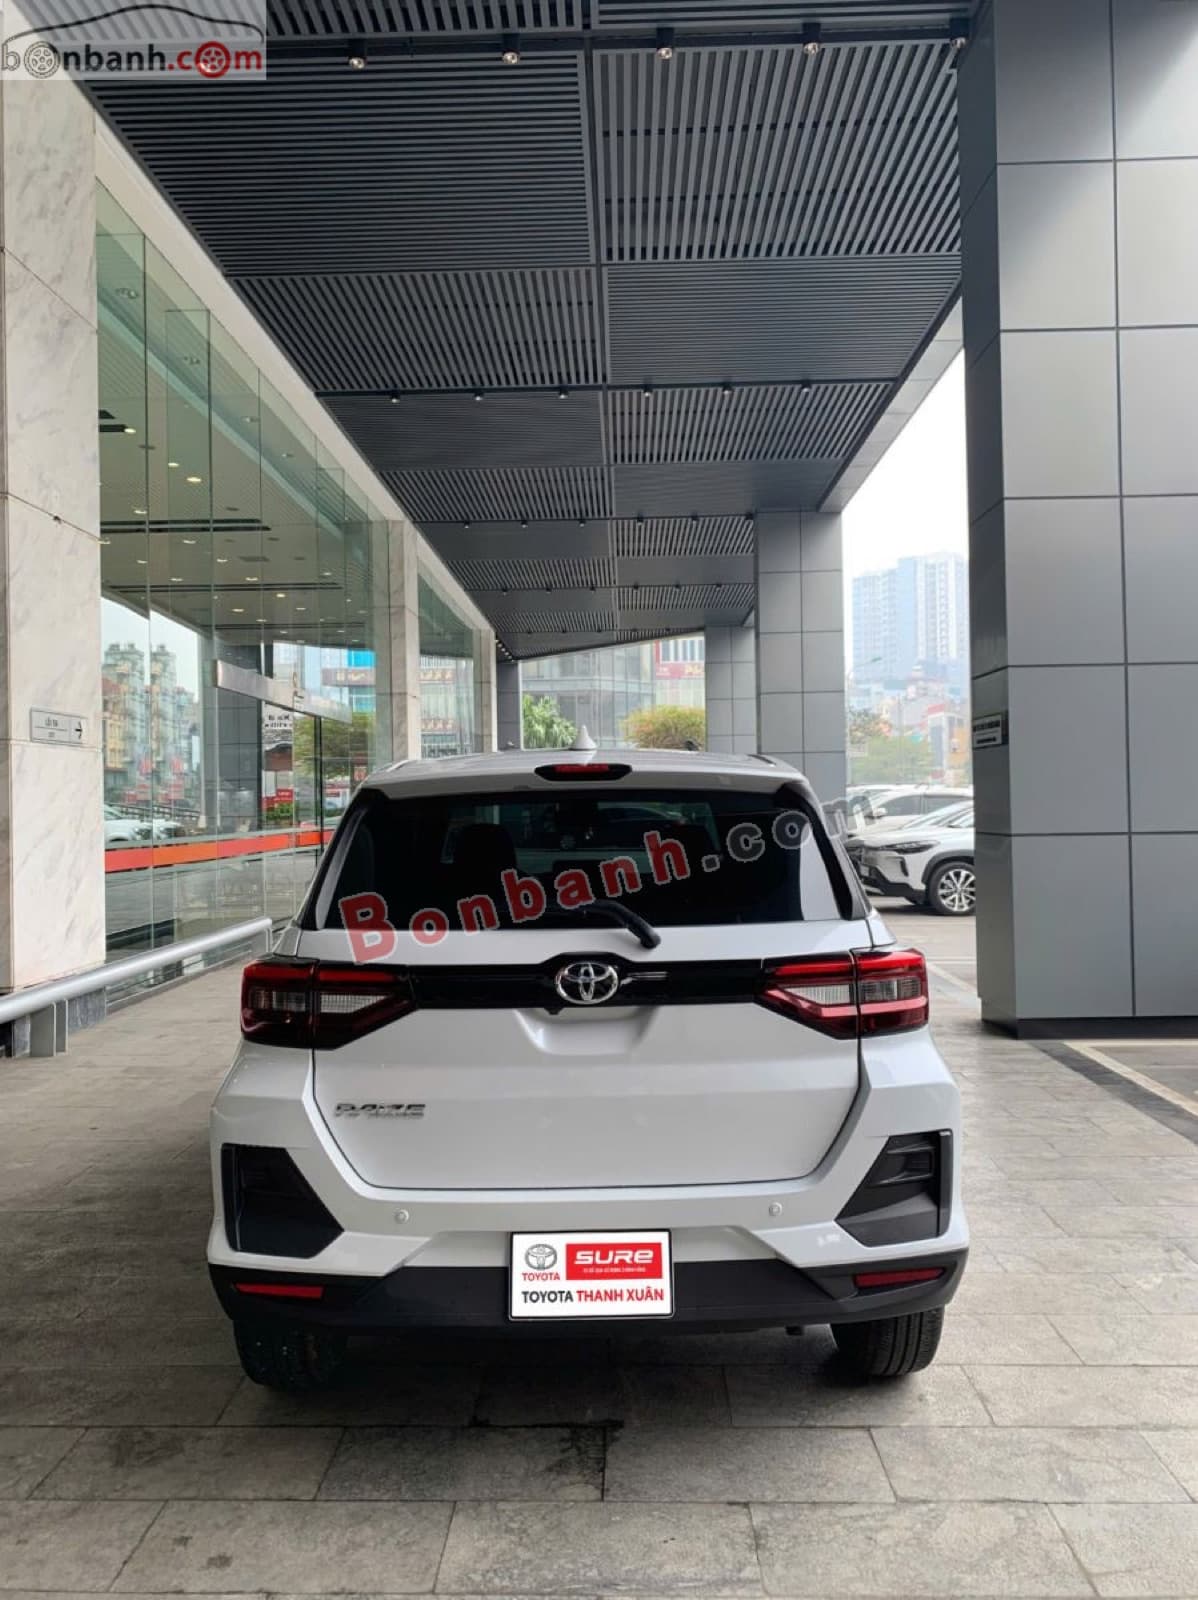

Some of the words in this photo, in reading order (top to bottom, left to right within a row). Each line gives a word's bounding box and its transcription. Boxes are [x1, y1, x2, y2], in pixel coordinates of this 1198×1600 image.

[522, 1272, 560, 1282] TOYOTA
[522, 1290, 573, 1304] TOYOTA
[577, 1288, 623, 1302] THANH
[627, 1286, 664, 1301] XUÂN
